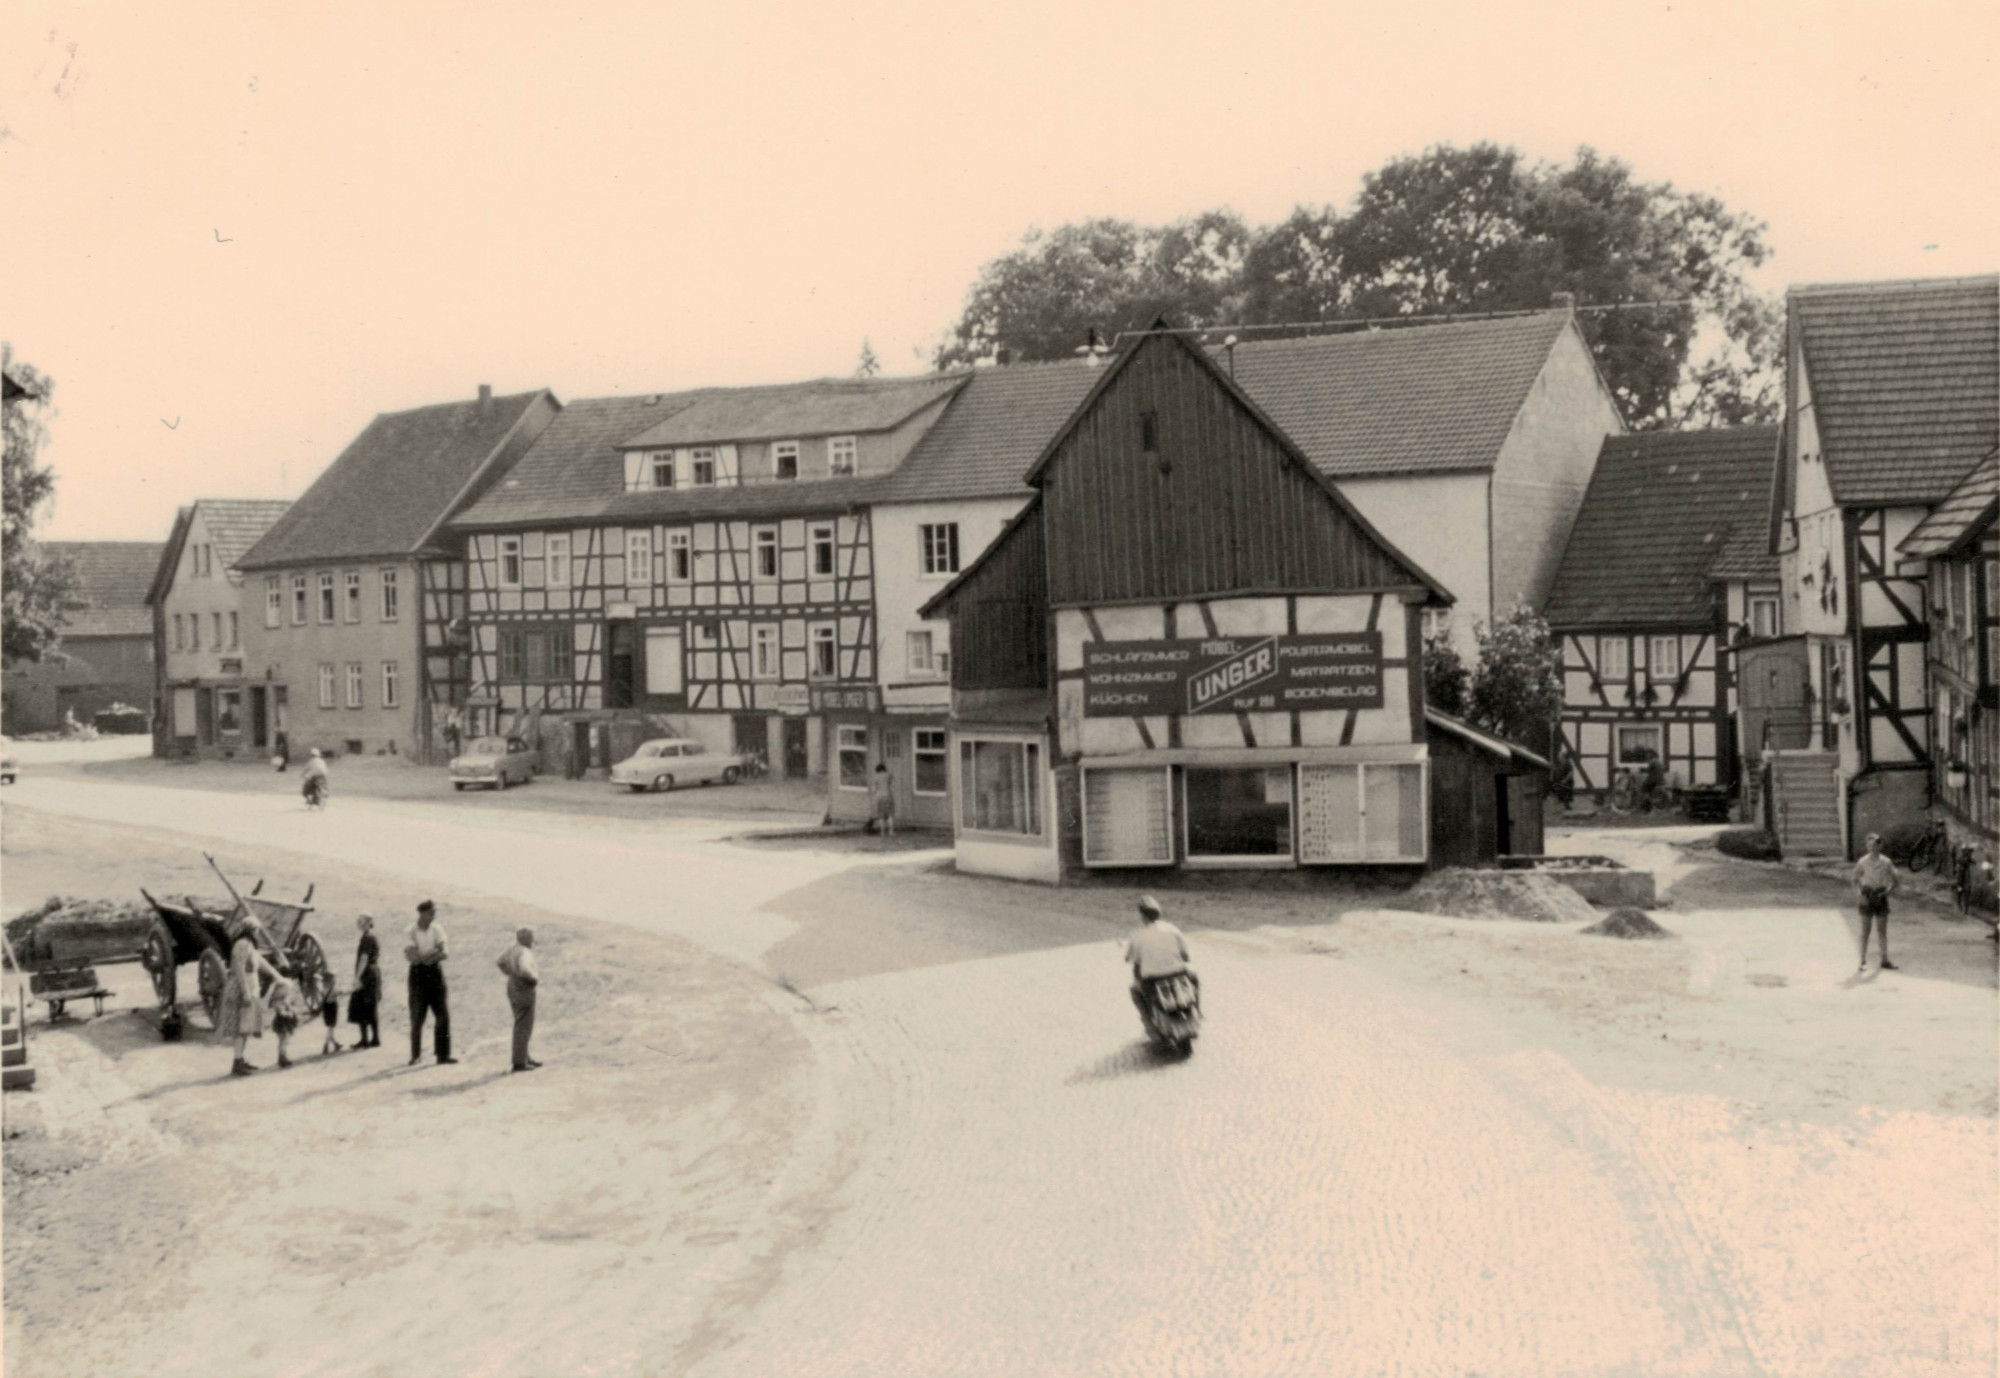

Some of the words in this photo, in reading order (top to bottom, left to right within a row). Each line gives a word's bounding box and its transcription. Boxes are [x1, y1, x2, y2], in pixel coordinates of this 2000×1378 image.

[1090, 650, 1190, 664] SCHLAFZIMMER
[1280, 643, 1374, 657] POLSTERMÖBEL
[1090, 671, 1177, 684] WOHNZIMMER
[1196, 648, 1271, 702] UNGER
[1290, 665, 1376, 678] MATRATZEN
[1090, 692, 1148, 705] KÜCHEN
[1284, 685, 1377, 699] BODENBELAG
